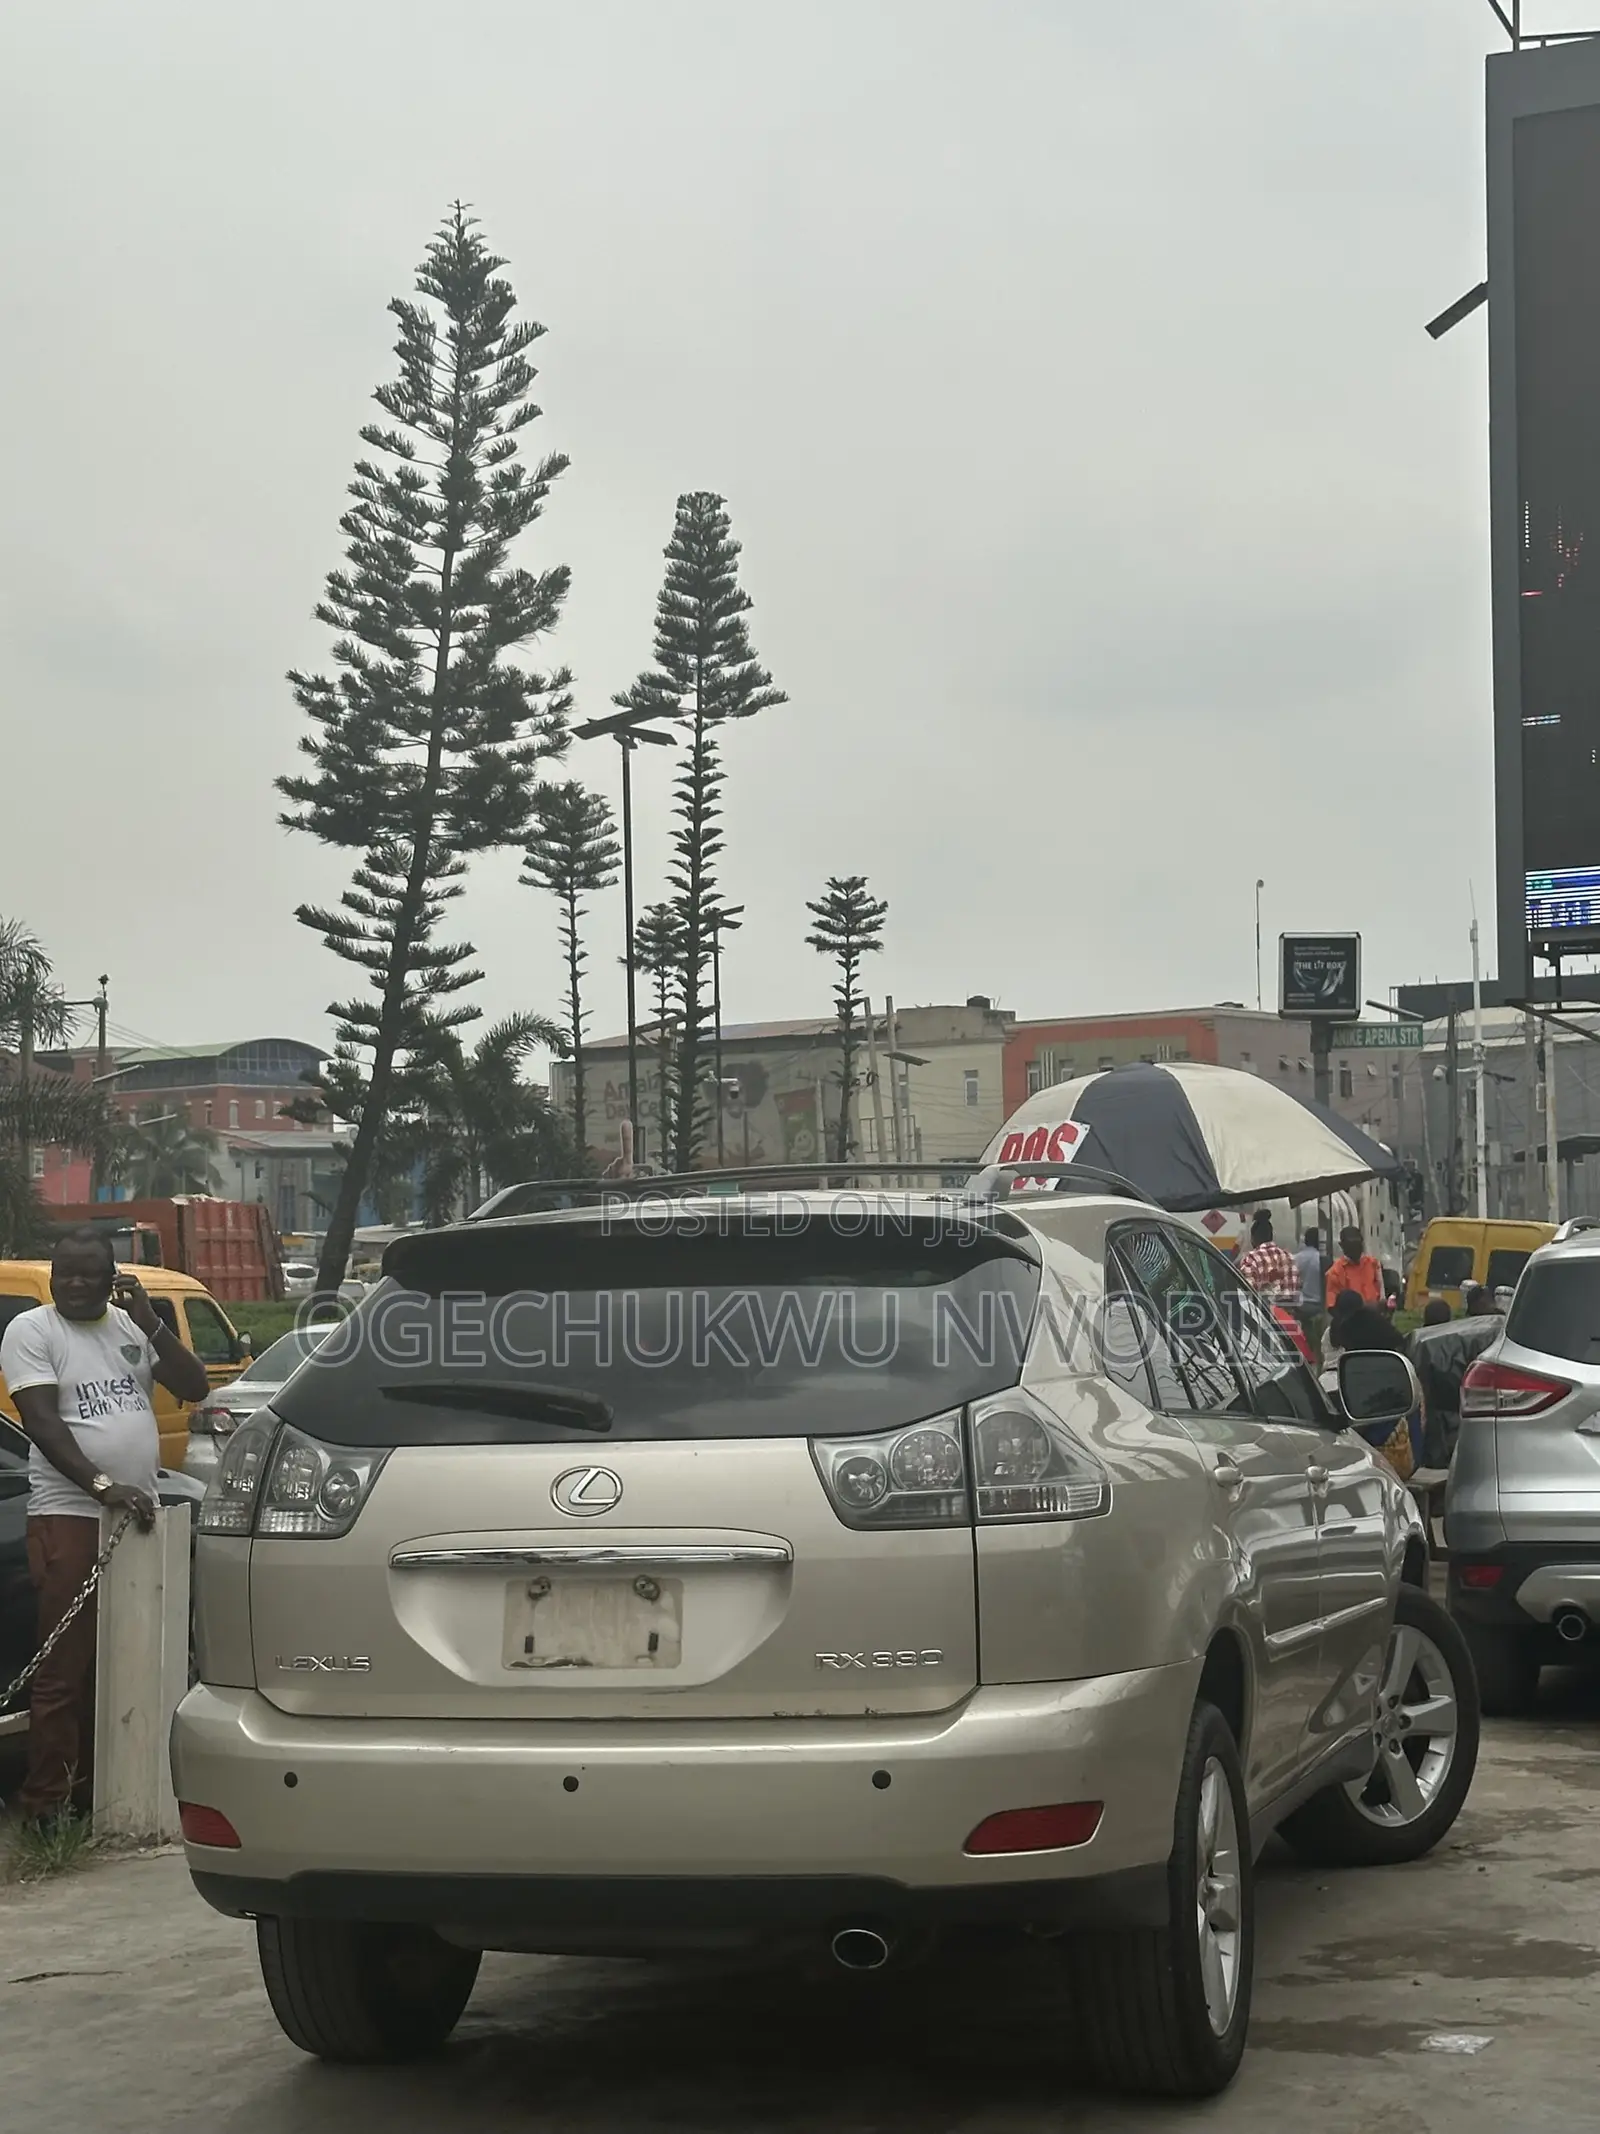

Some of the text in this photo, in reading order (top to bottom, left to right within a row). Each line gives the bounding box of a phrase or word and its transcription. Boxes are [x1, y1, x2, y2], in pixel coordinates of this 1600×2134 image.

[1333, 1027, 1419, 1047] ANIKE APENA STR
[76, 1373, 138, 1401] Invest
[275, 1655, 371, 1672] LEXUS
